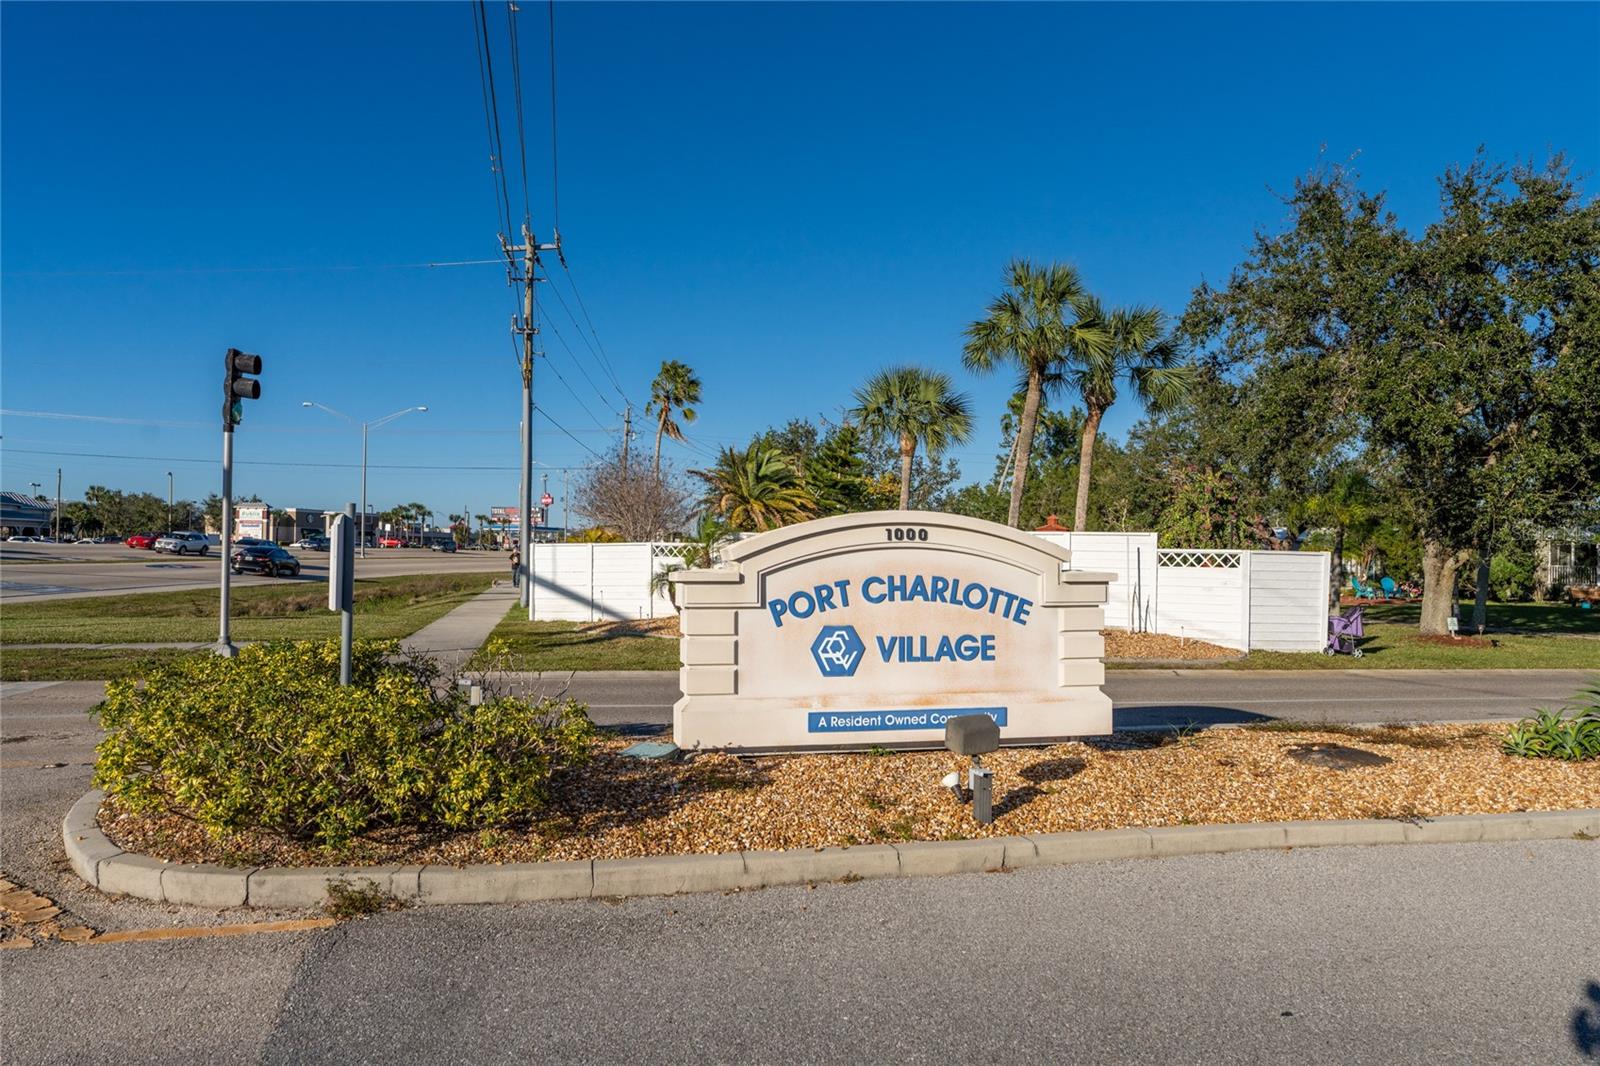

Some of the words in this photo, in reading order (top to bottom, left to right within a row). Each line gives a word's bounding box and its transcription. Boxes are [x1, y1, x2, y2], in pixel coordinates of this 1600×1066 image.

[885, 527, 929, 541] 1000
[768, 580, 851, 627] PORT
[861, 575, 1034, 626] CHARLOTTE
[877, 634, 996, 663] VILLAGE
[818, 716, 828, 728] A
[830, 715, 882, 728] Resident
[884, 713, 927, 726] Owned
